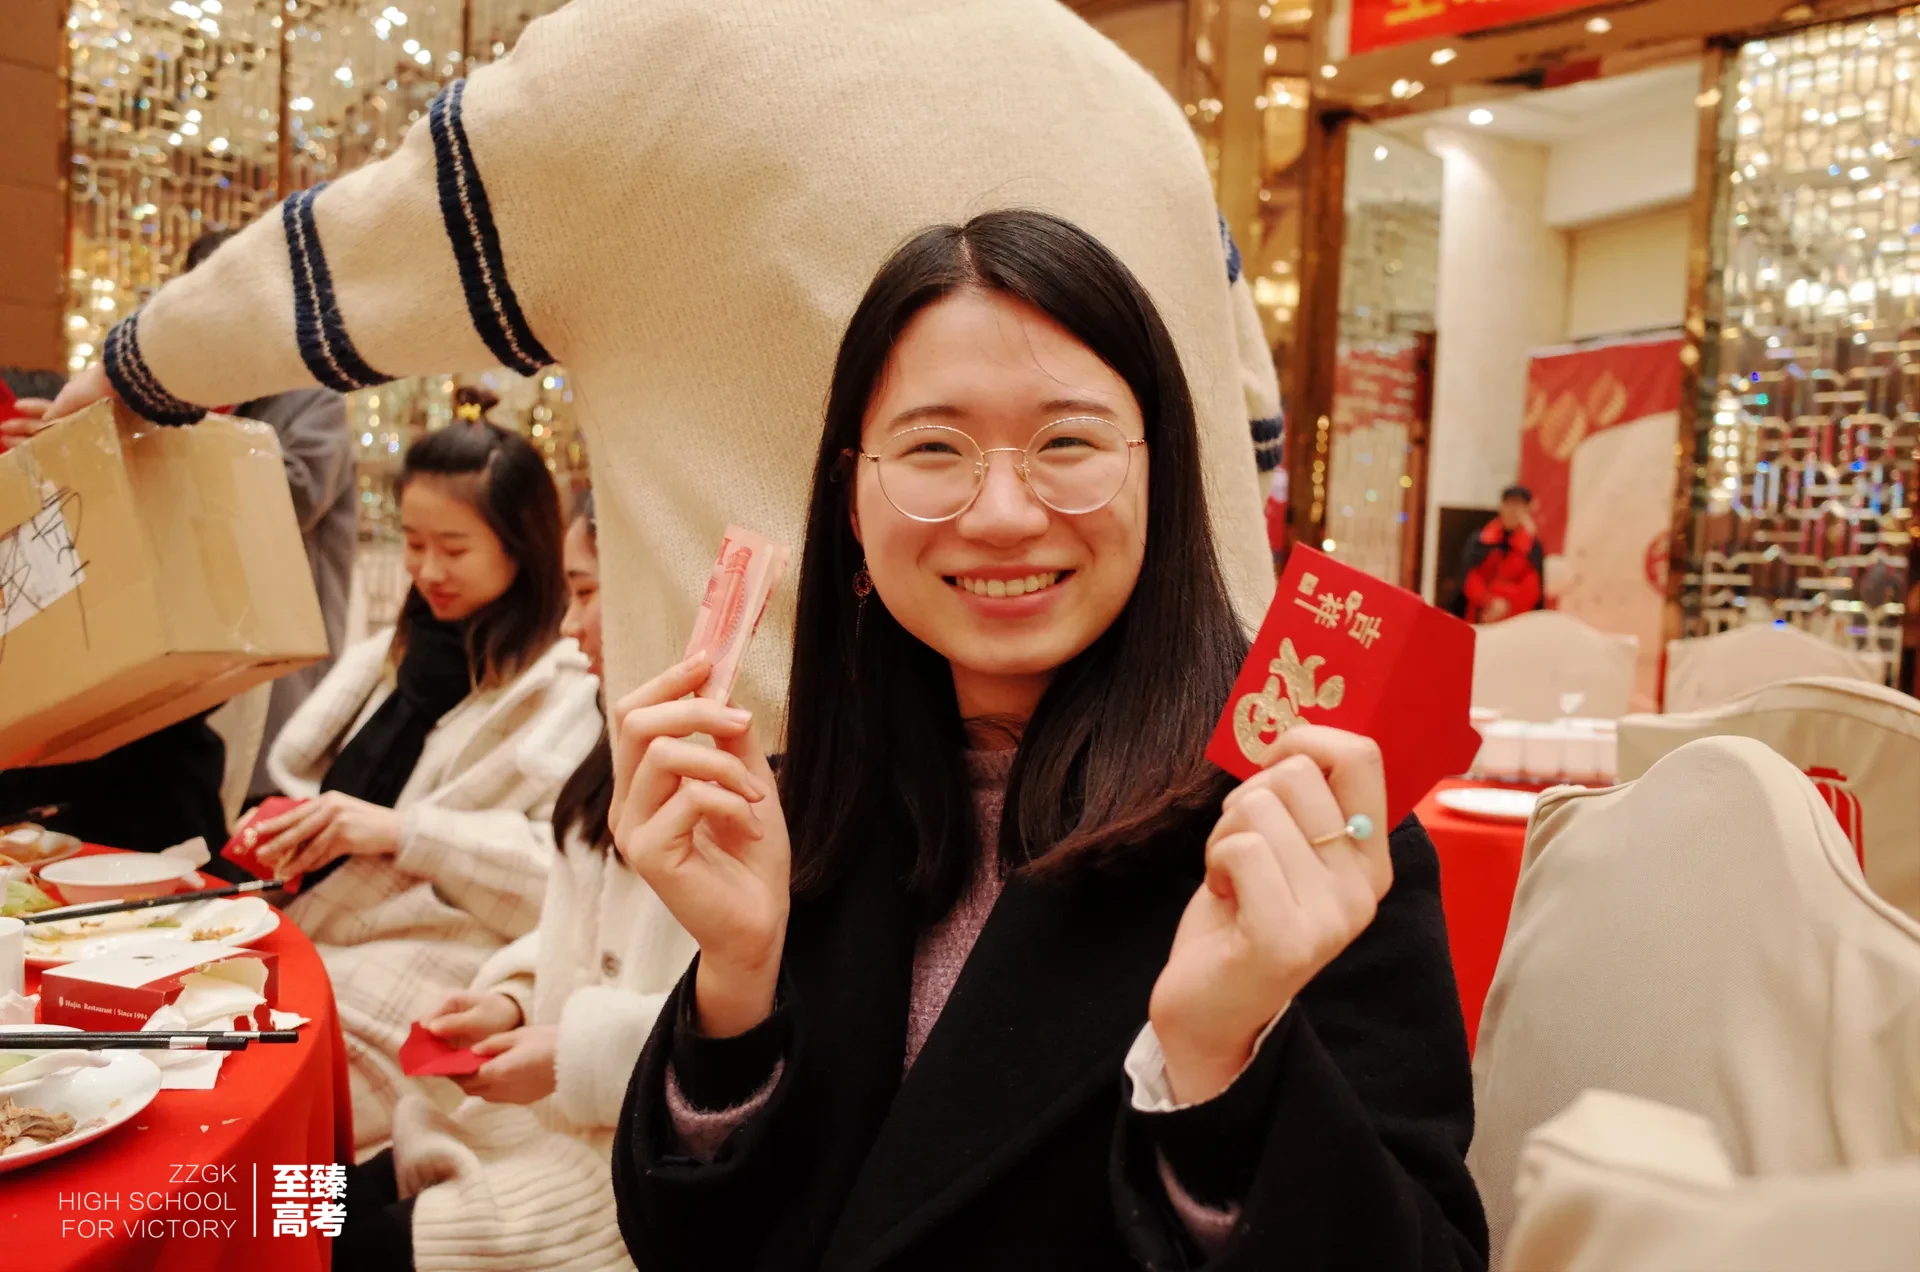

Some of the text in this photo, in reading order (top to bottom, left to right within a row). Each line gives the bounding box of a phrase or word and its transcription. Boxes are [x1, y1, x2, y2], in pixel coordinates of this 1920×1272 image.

[1294, 592, 1382, 649] 吉祥
[83, 1003, 113, 1014] Restaurant
[117, 1009, 133, 1018] Since
[133, 1012, 148, 1021] 1994
